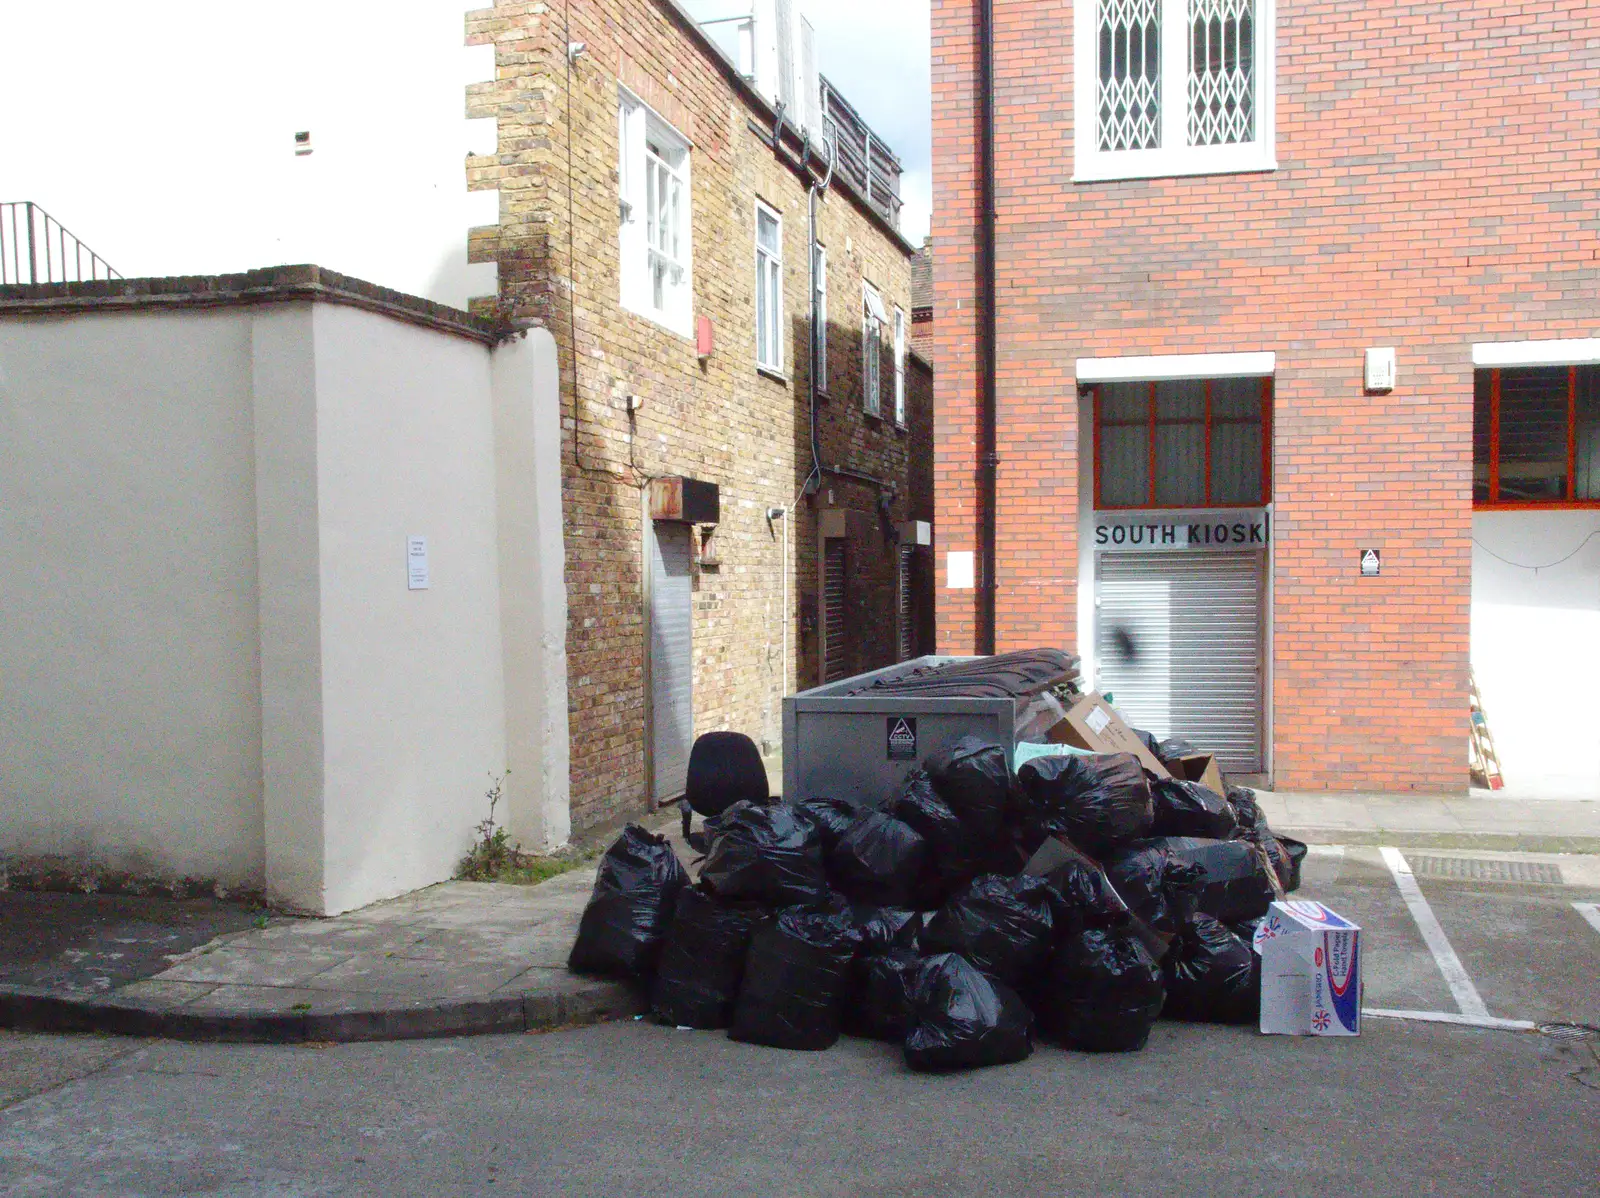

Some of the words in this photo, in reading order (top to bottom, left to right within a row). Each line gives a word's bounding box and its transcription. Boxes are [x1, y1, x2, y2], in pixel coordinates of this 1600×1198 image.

[1095, 524, 1176, 544] SOUTH
[1187, 523, 1263, 544] KIOSK
[1333, 931, 1341, 952] Paper
